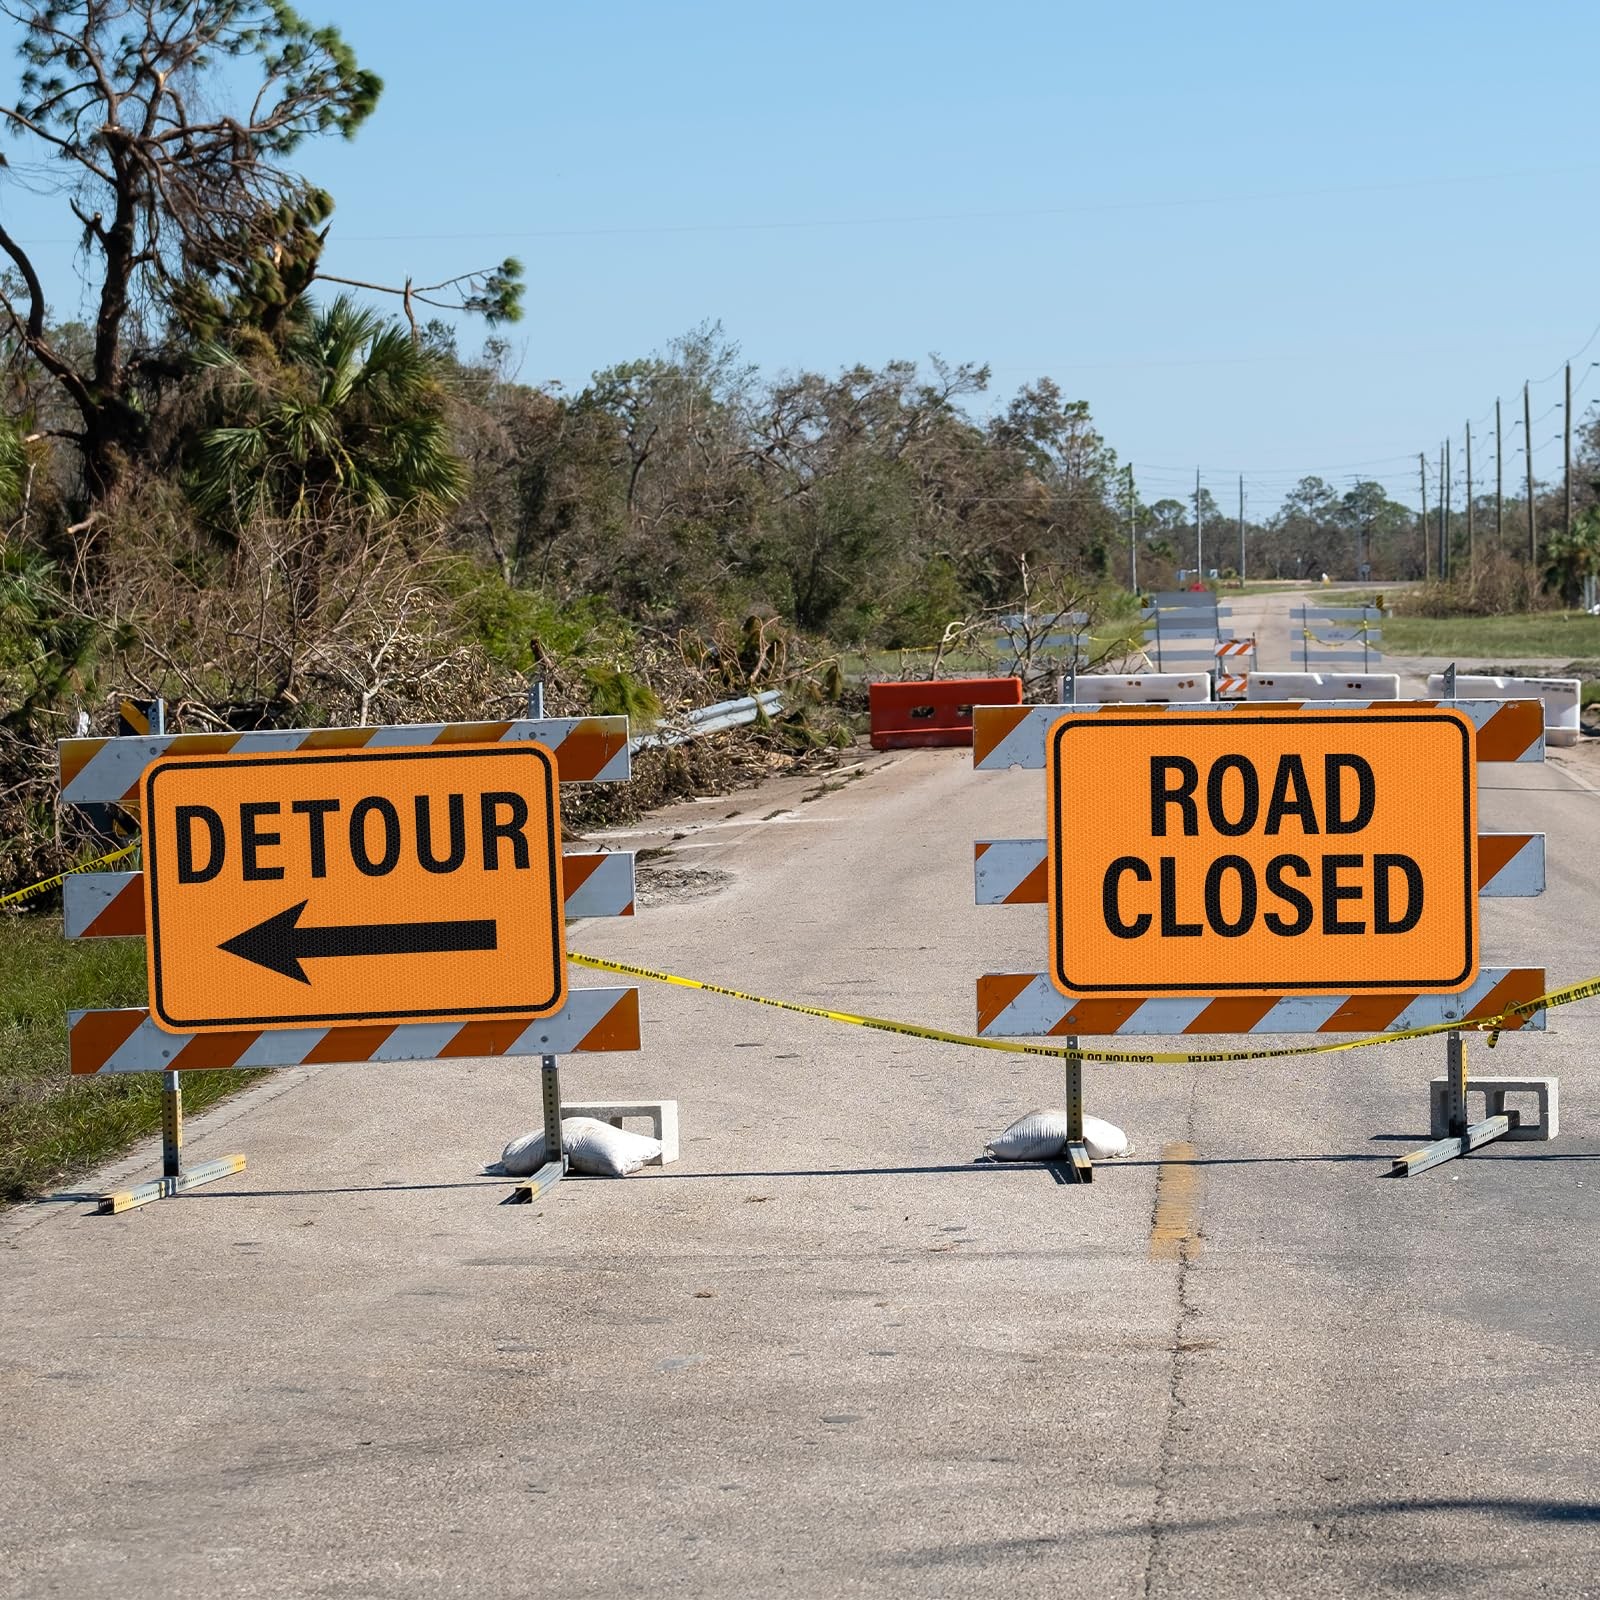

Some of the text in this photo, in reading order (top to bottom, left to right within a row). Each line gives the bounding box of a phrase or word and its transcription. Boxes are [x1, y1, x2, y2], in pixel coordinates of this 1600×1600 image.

[1149, 753, 1376, 837] ROAD
[175, 791, 530, 884] DETOUR
[1102, 853, 1425, 939] CLOSED
[1573, 986, 1590, 1000] DO
[1551, 994, 1571, 1006] NOT
[1063, 1051, 1084, 1060] NOT
[1087, 1053, 1102, 1061] DO
[1105, 1054, 1154, 1063] CAUTION
[1187, 1054, 1223, 1063] ENTER
[1228, 1053, 1249, 1061] NOT
